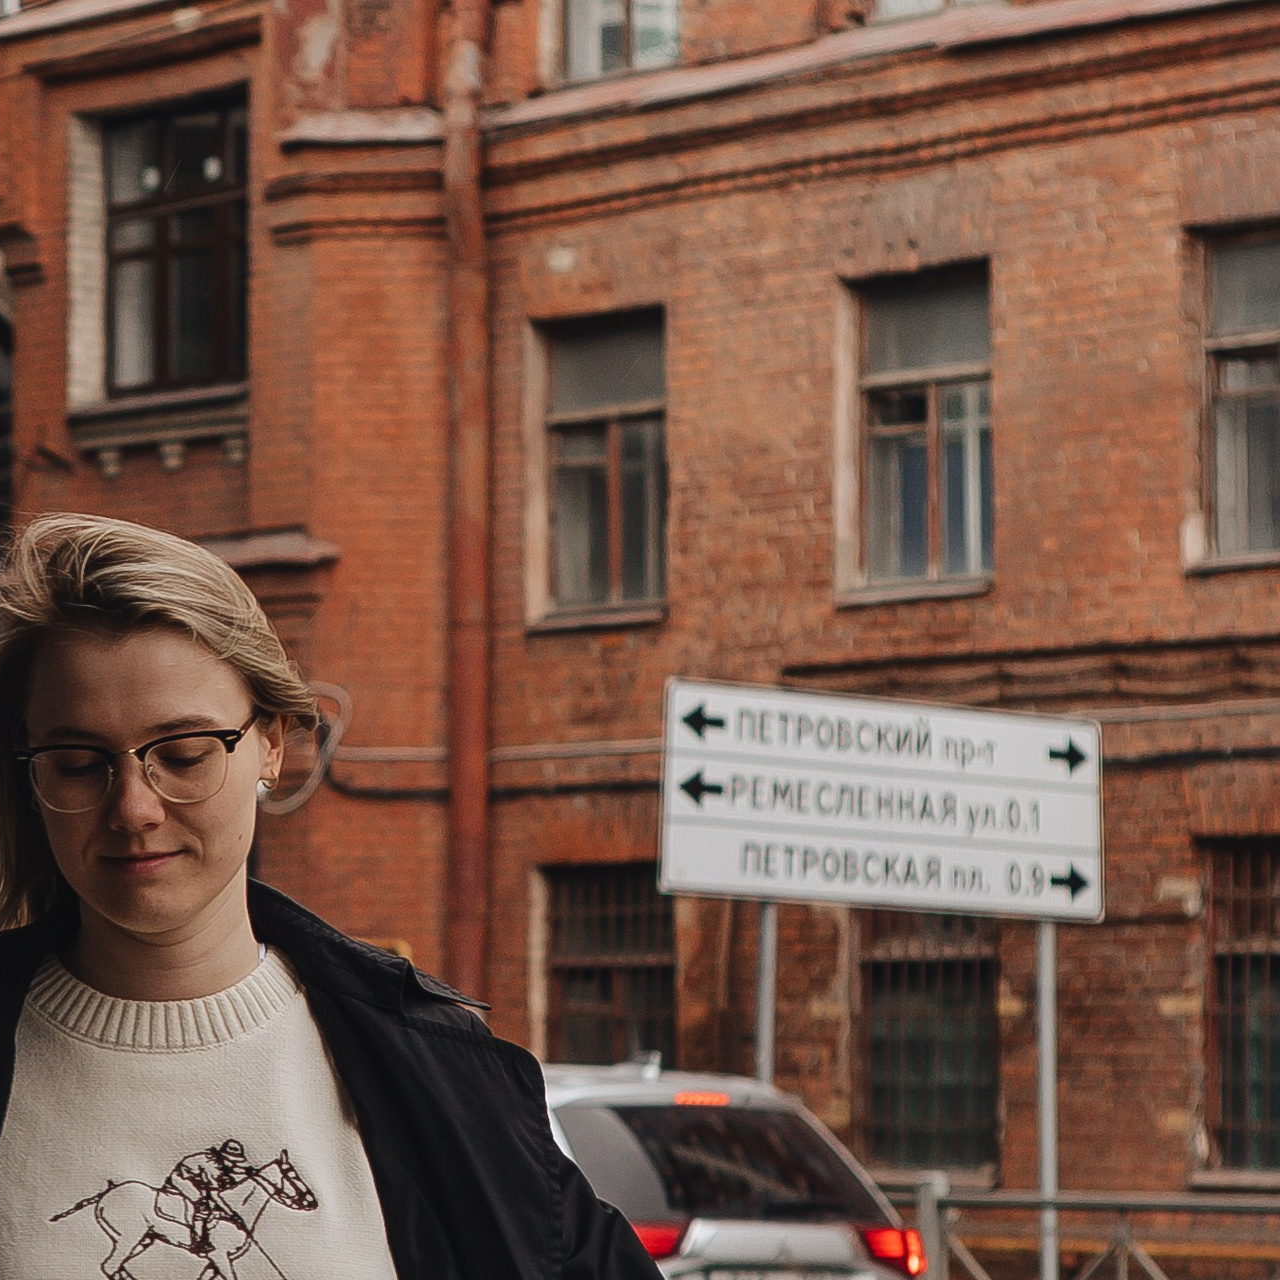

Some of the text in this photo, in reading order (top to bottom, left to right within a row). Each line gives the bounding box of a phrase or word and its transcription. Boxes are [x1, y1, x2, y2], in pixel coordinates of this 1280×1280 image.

[735, 708, 996, 769] ПЕТРОВСКИЙ пр-т
[728, 772, 957, 828] РЕМЕСЛЕННАЯ
[741, 840, 942, 890] ПЕТРОВСКАЯ
[951, 866, 990, 894] пл.
